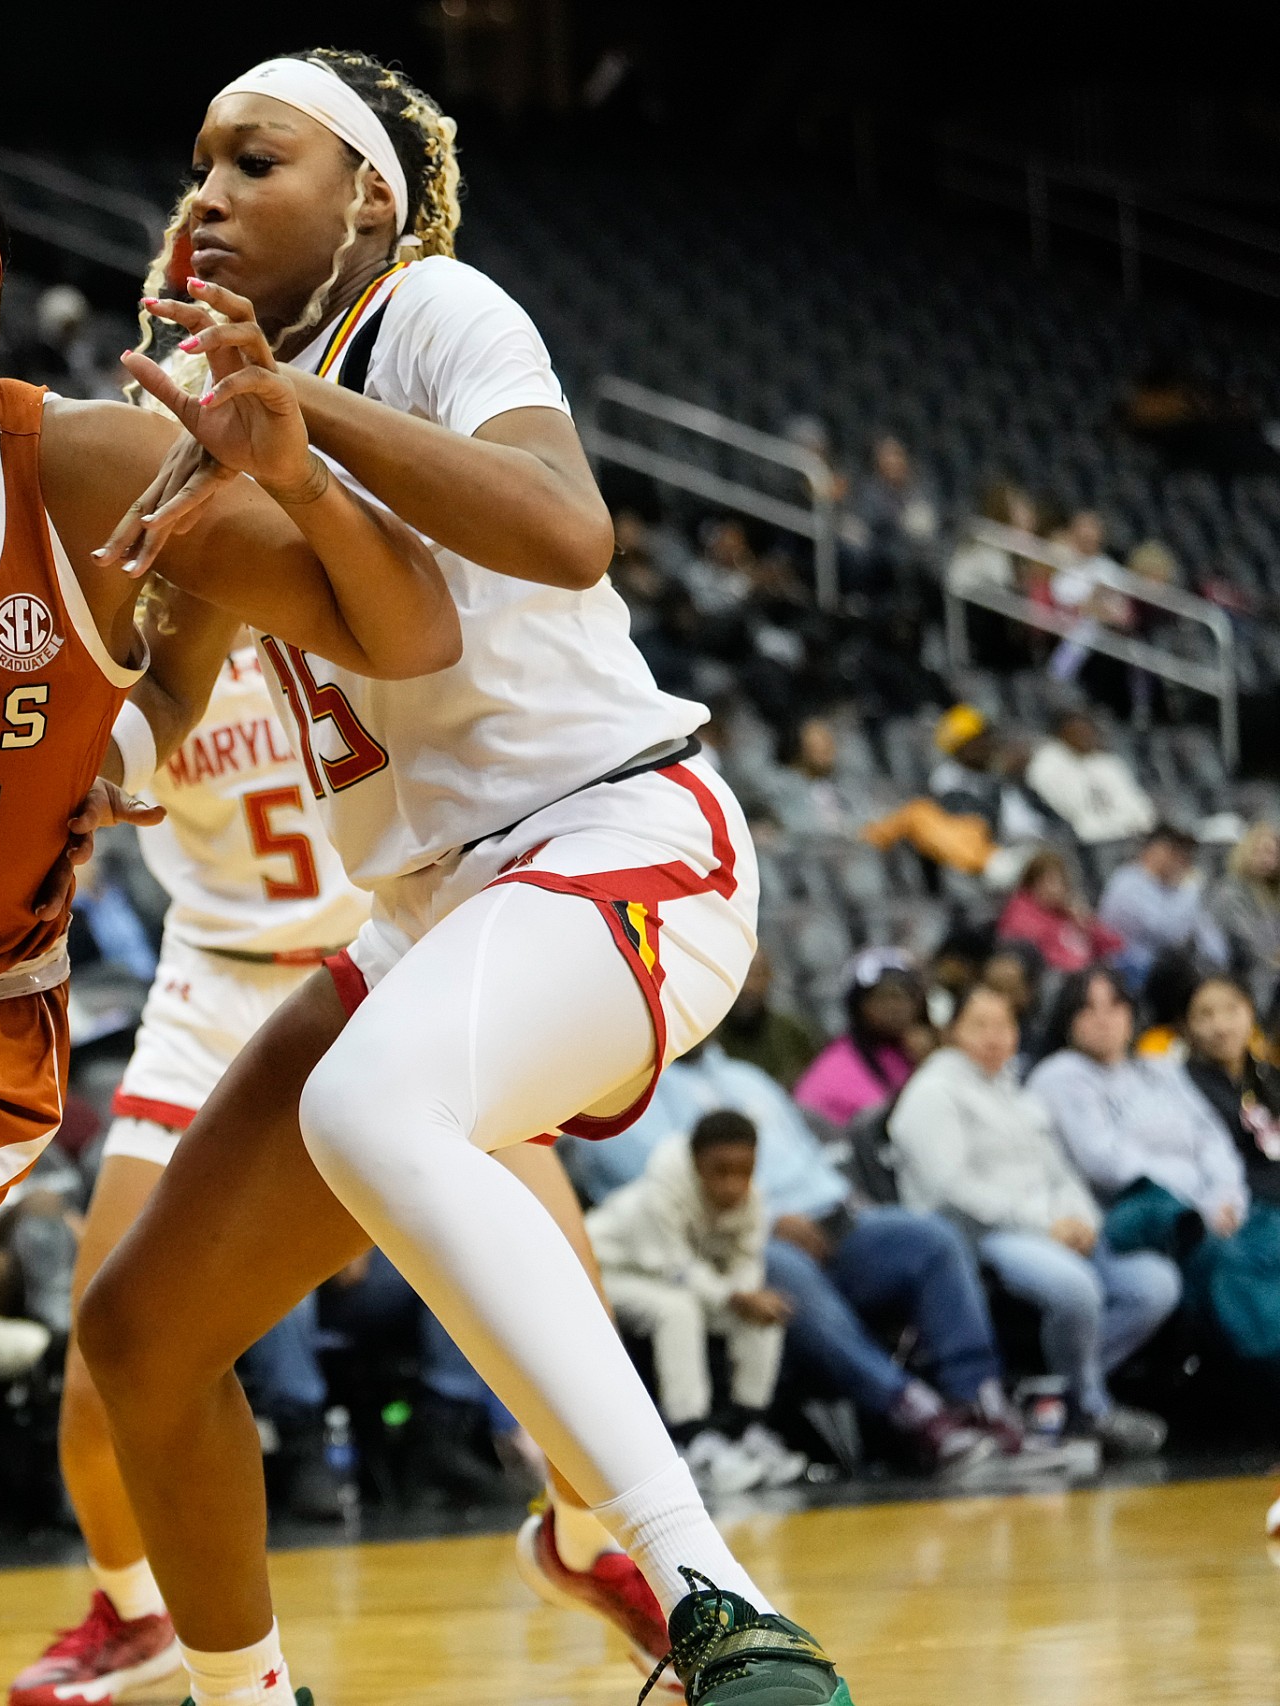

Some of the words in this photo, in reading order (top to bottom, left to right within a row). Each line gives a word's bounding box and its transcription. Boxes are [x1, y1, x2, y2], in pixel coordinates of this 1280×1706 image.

[166, 717, 297, 790] MARYL
[261, 634, 389, 799] 15
[242, 784, 321, 901] 5
